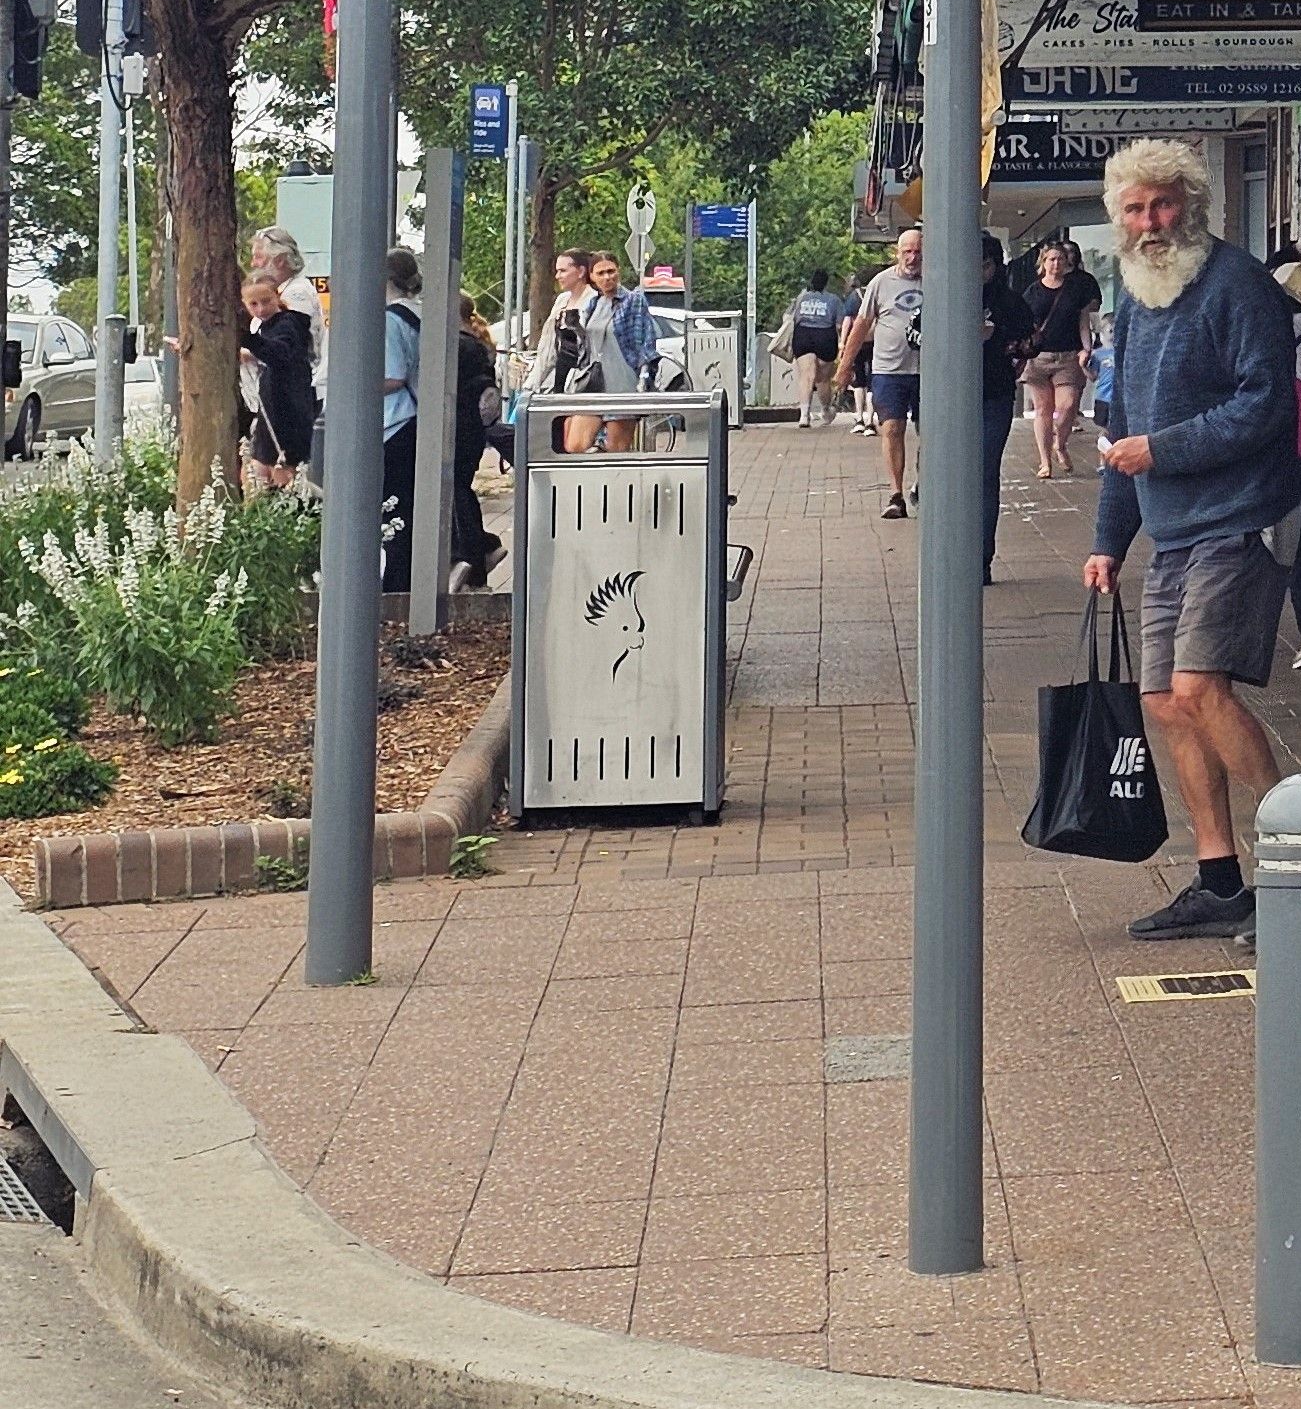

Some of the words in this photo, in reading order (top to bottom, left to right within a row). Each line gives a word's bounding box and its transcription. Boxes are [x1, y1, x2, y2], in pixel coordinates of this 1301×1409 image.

[1093, 0, 1139, 34] Sta
[1156, 3, 1193, 18] EAT
[1210, 3, 1229, 18] IN
[1043, 40, 1085, 48] CAKES
[1152, 38, 1195, 47] ROLLS
[1185, 82, 1215, 94] TEL.
[1218, 82, 1233, 94] 02
[1237, 82, 1268, 94] 9589
[1272, 82, 1301, 94] 1216
